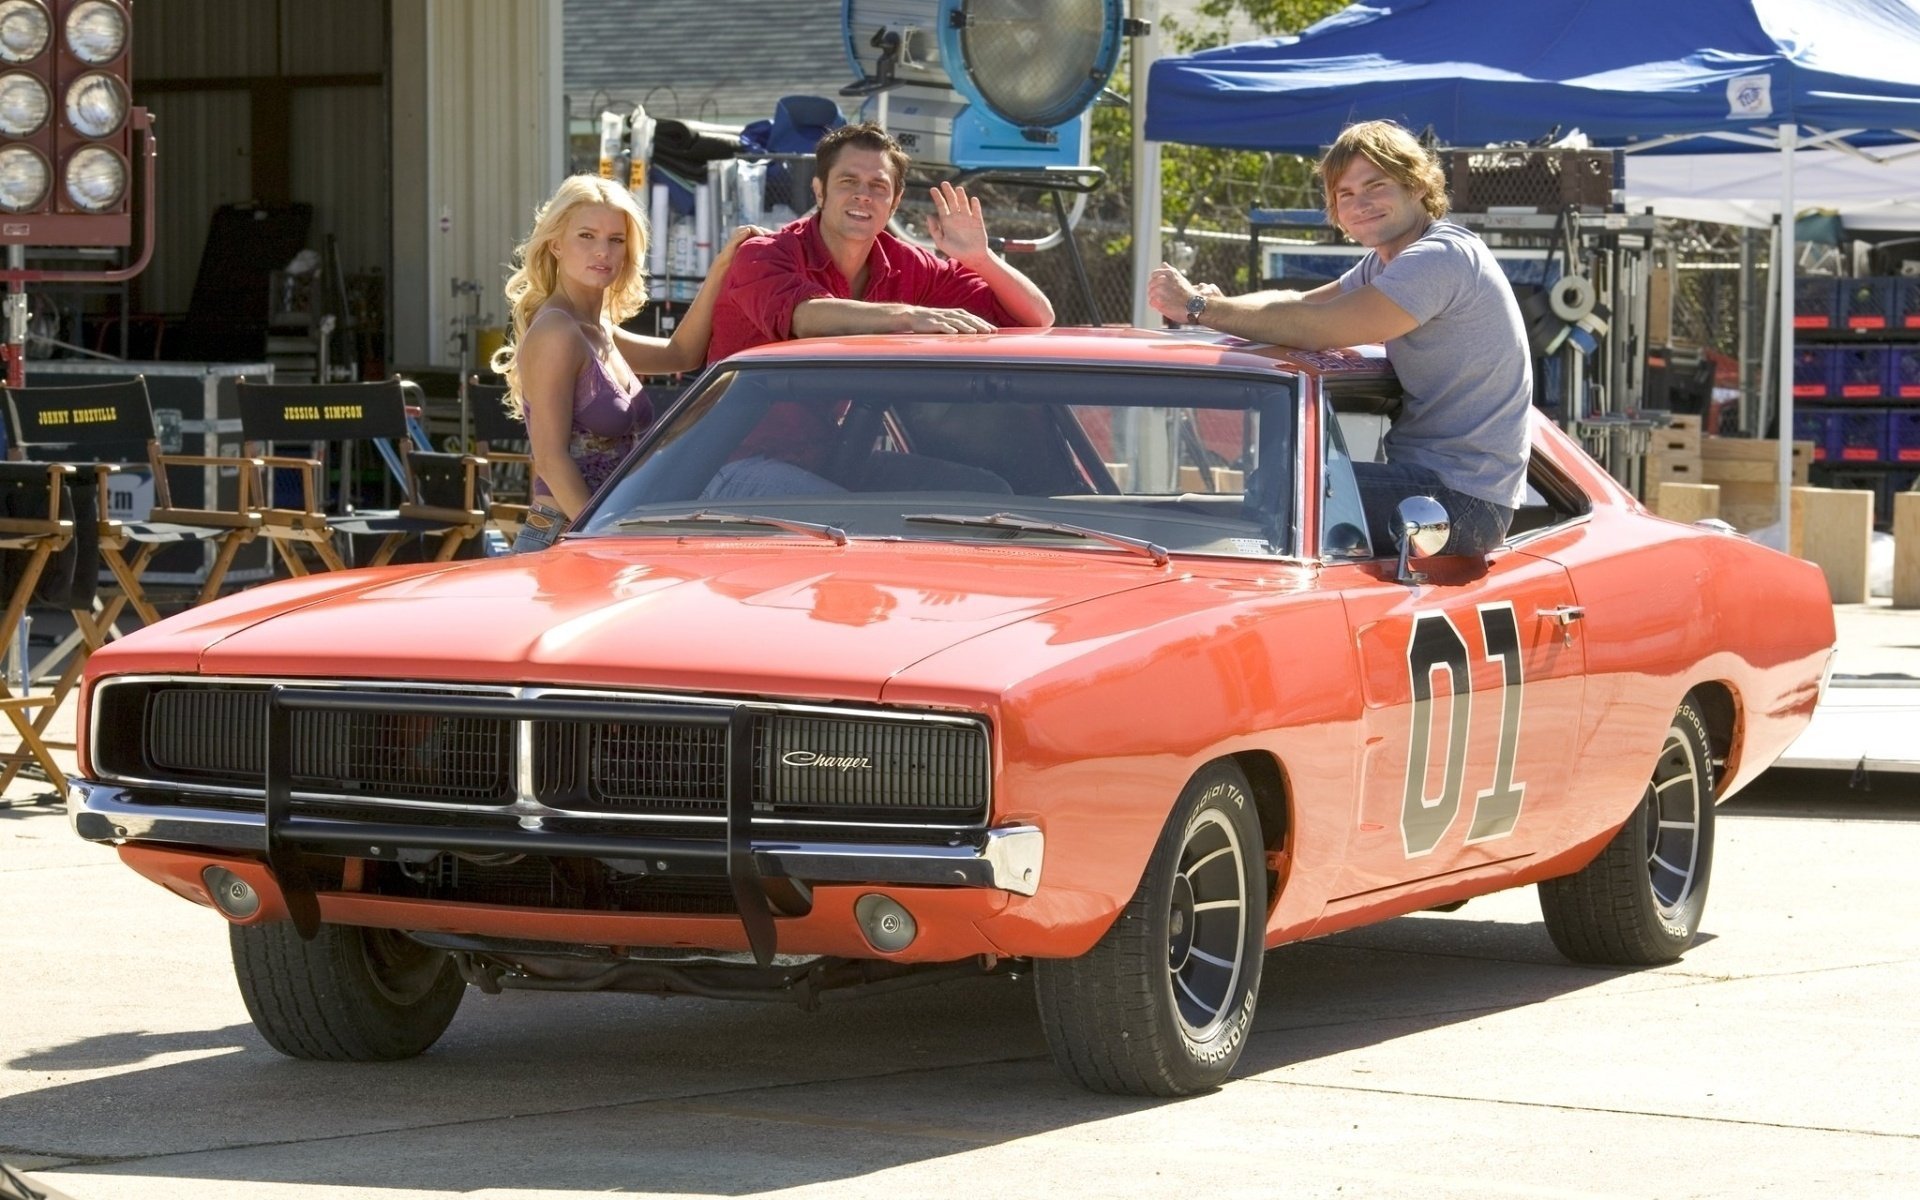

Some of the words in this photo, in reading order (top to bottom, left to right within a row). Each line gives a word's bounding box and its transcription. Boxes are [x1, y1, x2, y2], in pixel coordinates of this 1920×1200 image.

[39, 410, 69, 425] JOHNNY
[73, 407, 117, 423] KNOXVILLE
[284, 406, 320, 420] JESSICA
[324, 405, 363, 419] SIMPSON
[1400, 600, 1526, 860] 01
[1676, 705, 1713, 792] FGoodrich
[783, 751, 872, 772] Charger
[1226, 784, 1245, 810] T/A
